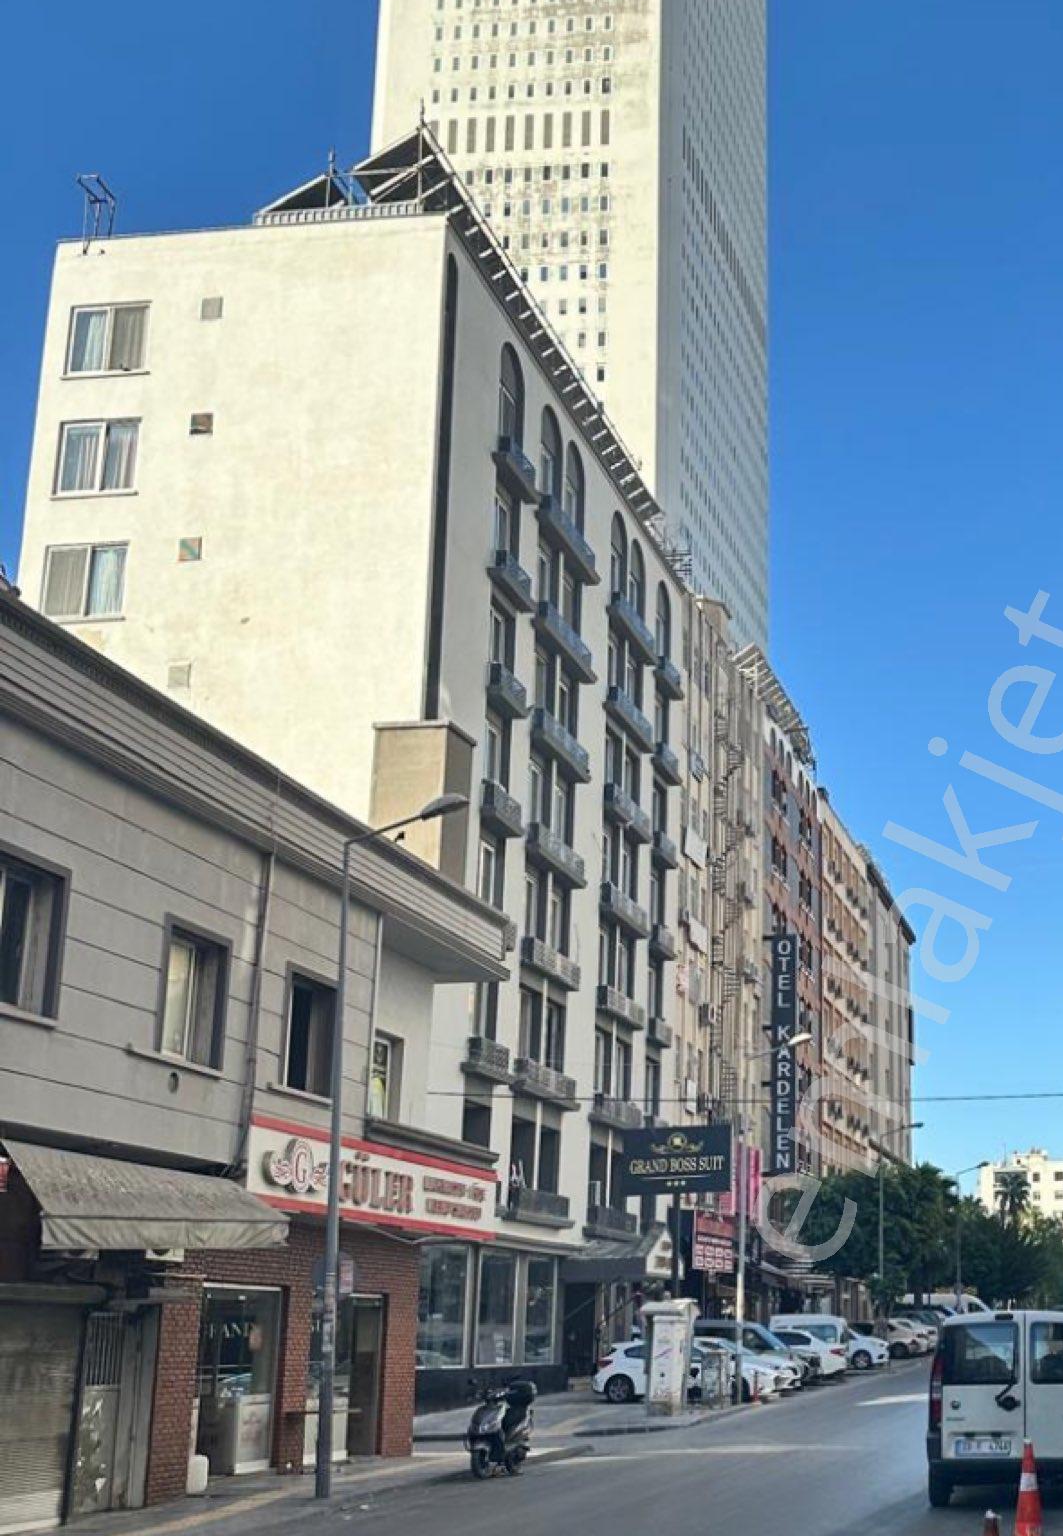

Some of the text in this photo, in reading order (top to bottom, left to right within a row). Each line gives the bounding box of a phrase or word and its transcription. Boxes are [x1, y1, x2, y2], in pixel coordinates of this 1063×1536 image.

[776, 940, 791, 1170] OTEL KARDELEN
[338, 1150, 414, 1214] GÜLER
[630, 1154, 725, 1175] GRAND BOSS SUIT
